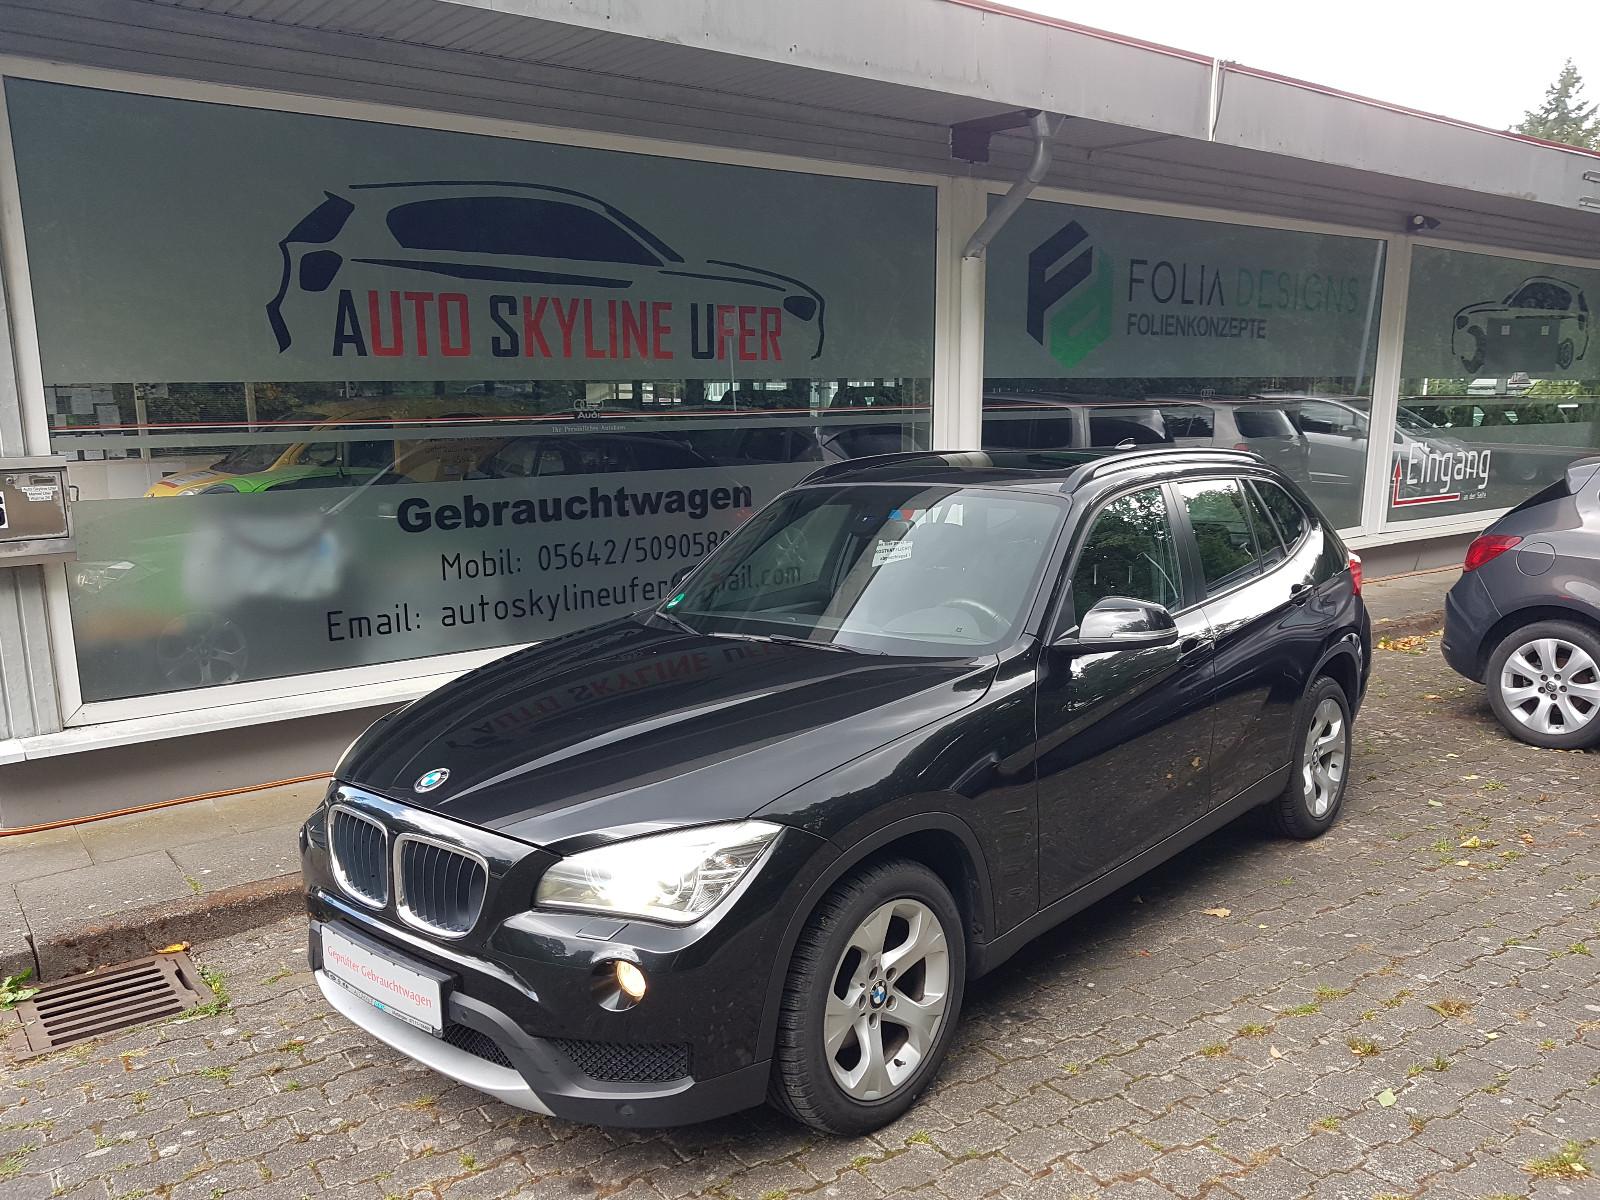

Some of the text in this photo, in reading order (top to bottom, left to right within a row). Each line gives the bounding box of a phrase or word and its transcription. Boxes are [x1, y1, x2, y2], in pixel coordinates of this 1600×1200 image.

[1128, 258, 1360, 313] FOLIA DESIGNS
[332, 288, 783, 362] AUTO SKYLINE UFER
[1127, 312, 1267, 340] FOLIENKONZEPTE
[577, 411, 601, 420] Audi
[1406, 442, 1491, 493] Eingang
[398, 483, 753, 532] Gebrauchtwagen
[440, 551, 523, 581] Mobil:
[327, 606, 422, 642] Email:
[327, 945, 360, 972] Geprüfter
[361, 965, 432, 1009] Gebrauchtwagen
